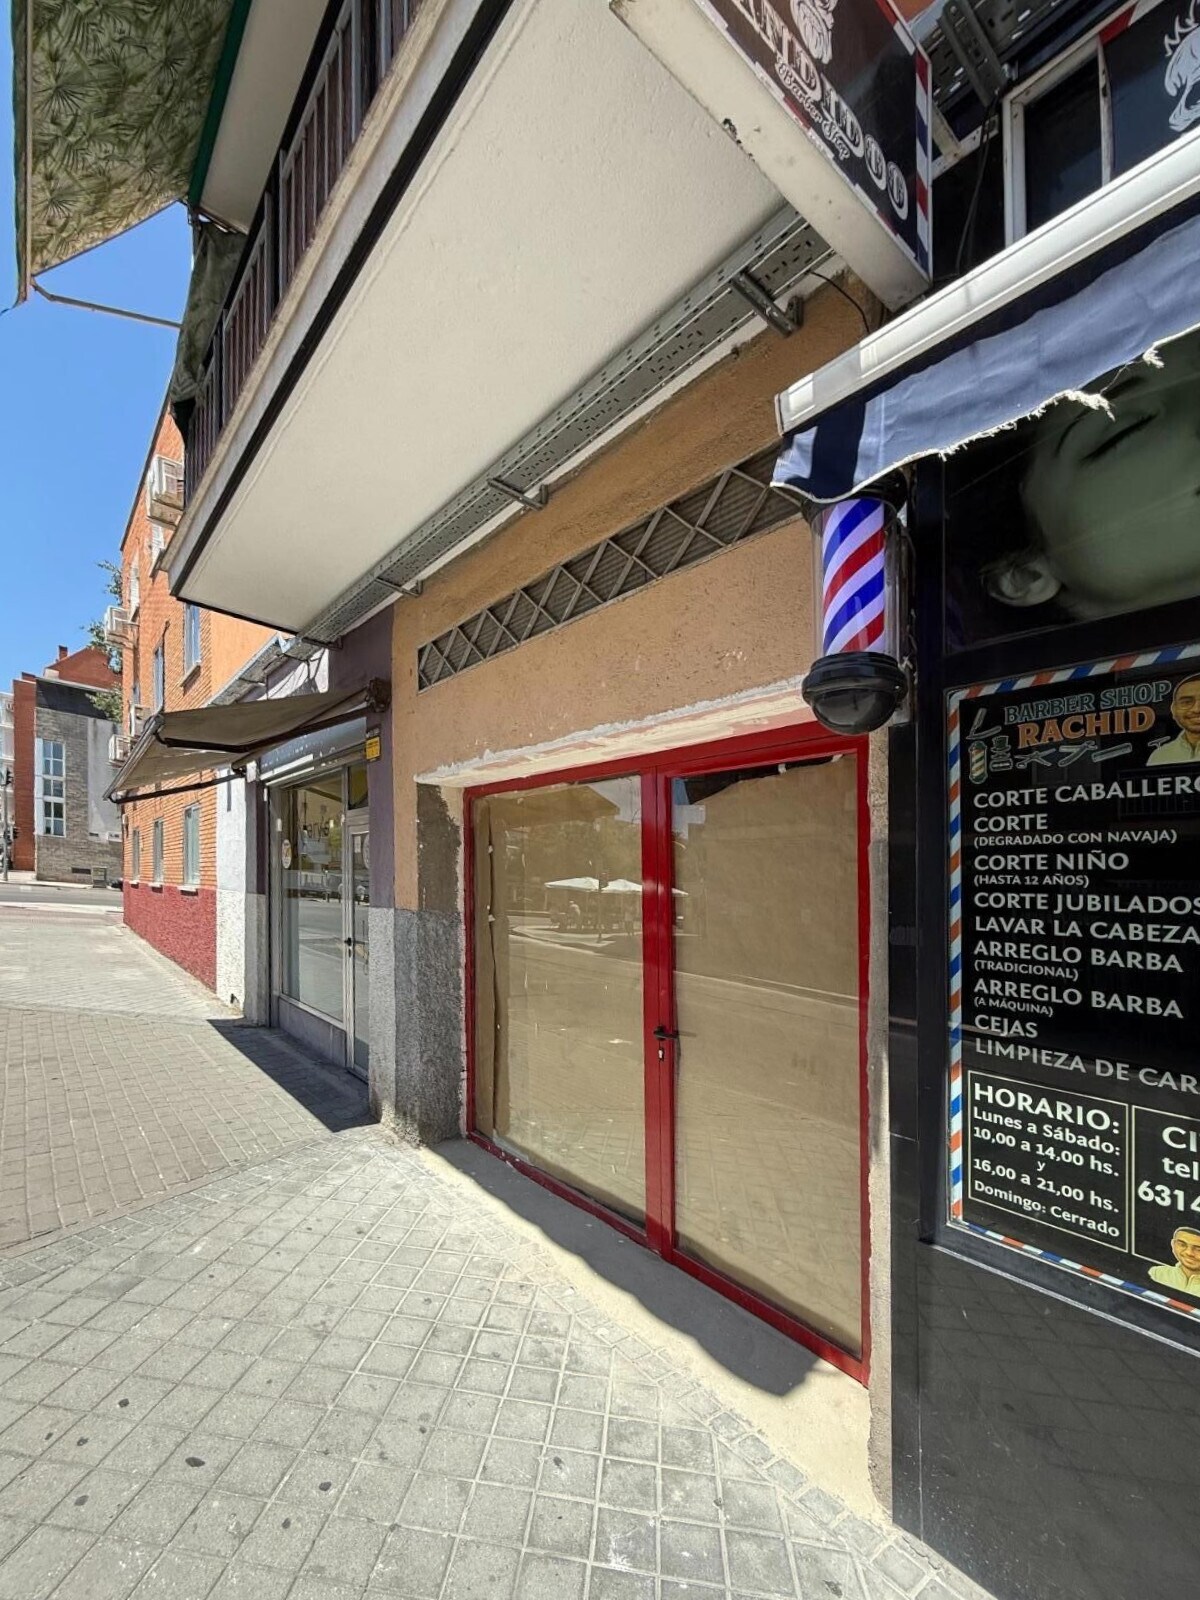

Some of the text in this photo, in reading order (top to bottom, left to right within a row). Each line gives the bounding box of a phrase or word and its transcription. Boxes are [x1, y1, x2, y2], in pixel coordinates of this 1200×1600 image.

[775, 50, 851, 160] Barber Shop
[1004, 680, 1172, 725] BARBER SHOP
[1017, 705, 1156, 749] RACHID
[973, 787, 1048, 808] CORTE
[973, 813, 1048, 833] CORTE
[973, 829, 1177, 849] (DEGRADADO CON NAVAJA)
[973, 850, 1129, 871] CORTE NIÑO
[973, 873, 1090, 888] (HASTA 12 AÑOS)
[973, 892, 1049, 910] CORTE
[975, 916, 1200, 945] LAVAR LA CABEZA
[973, 940, 1184, 973] ARREGLO BARBA
[973, 959, 1079, 982] (TRADICIONAL)
[973, 978, 1184, 1019] ARREGLO BARBA
[973, 996, 987, 1008] (A
[974, 1014, 1039, 1039] CEJAS
[975, 1037, 1200, 1095] LIMPIEZA DE CAR
[974, 1082, 1120, 1134] HORARIO:
[973, 1106, 1121, 1156] Lunes a Sábado:
[1161, 1126, 1200, 1153] CI
[973, 1126, 1119, 1177] 10,00 a 14,00 hs.
[1036, 1161, 1046, 1172] y
[973, 1158, 1120, 1213] 16,00 a 21,00 hs.
[974, 1180, 1120, 1238] Domingo: Cerrado
